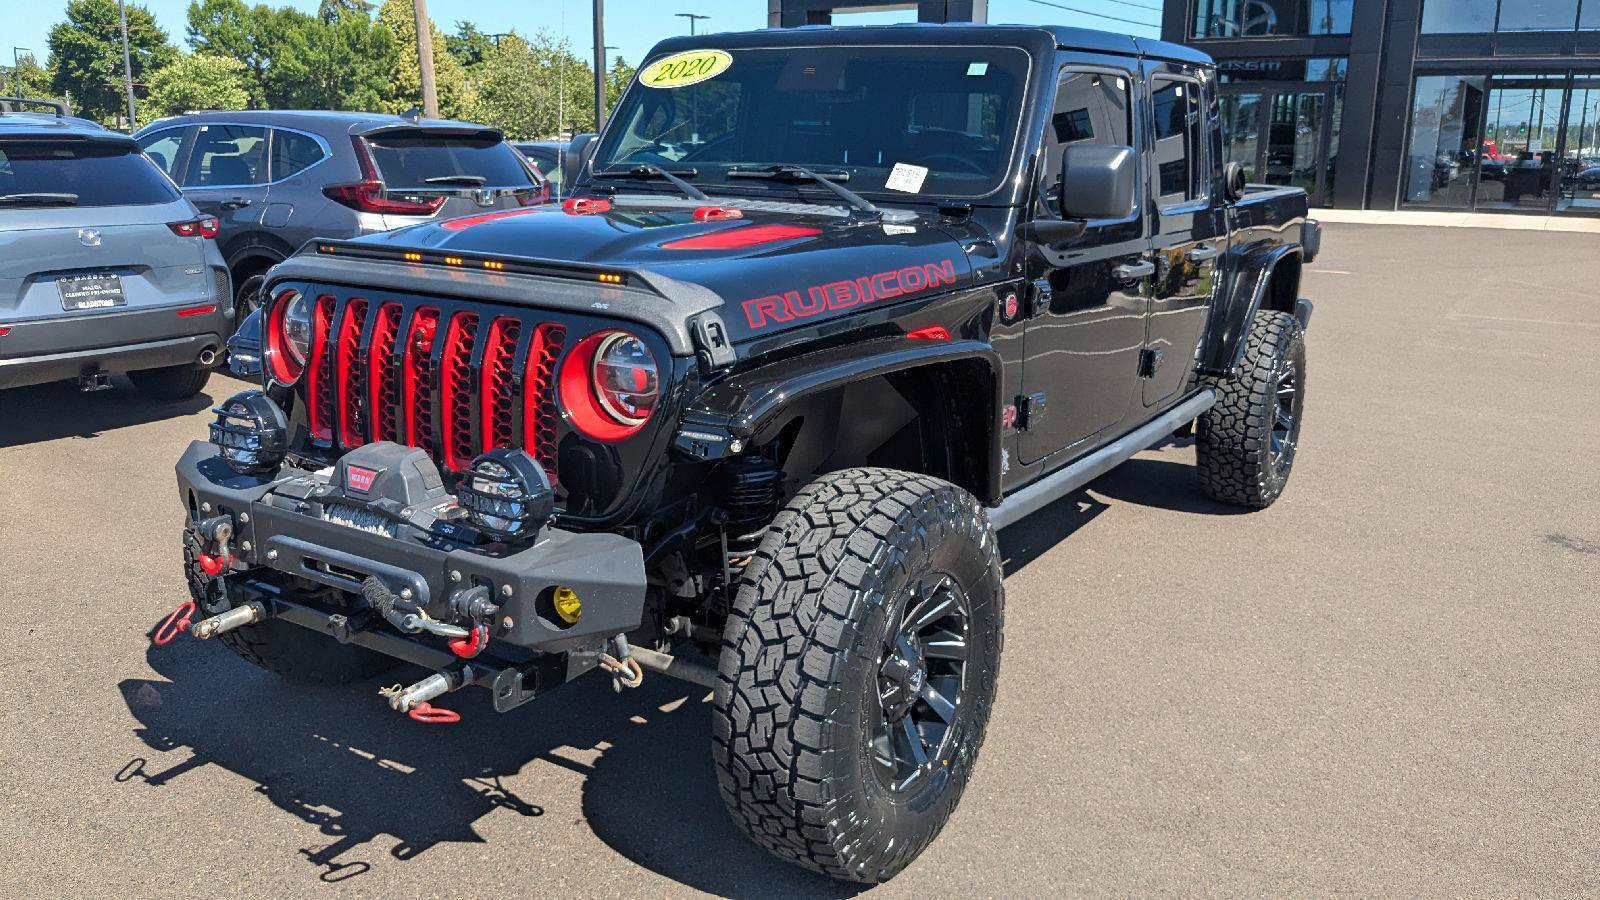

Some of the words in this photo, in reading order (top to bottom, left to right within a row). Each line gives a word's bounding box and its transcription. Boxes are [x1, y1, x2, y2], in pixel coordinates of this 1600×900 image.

[653, 56, 717, 82] 2020
[741, 259, 957, 329] RUBICON
[351, 473, 370, 484] WARN
